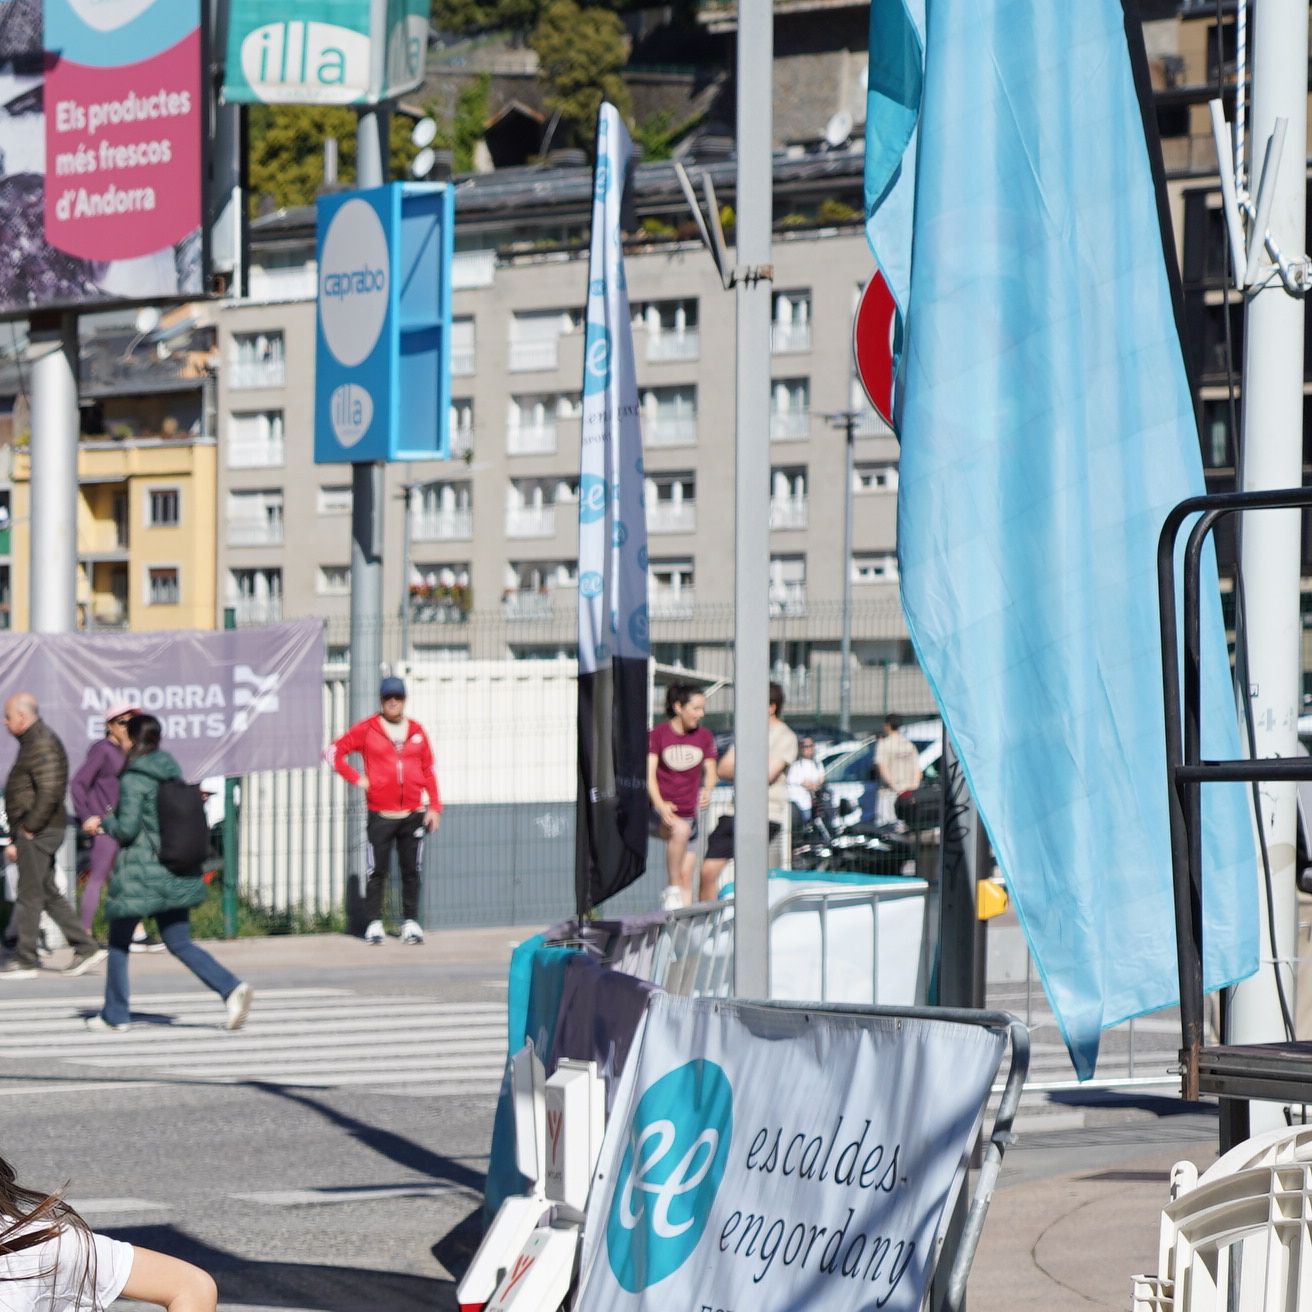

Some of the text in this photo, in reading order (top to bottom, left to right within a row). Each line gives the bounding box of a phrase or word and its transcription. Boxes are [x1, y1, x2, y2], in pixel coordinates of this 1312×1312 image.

[260, 22, 347, 85] illa
[55, 88, 191, 136] Els productes
[55, 139, 172, 176] més frescos
[55, 182, 156, 221] d'Andorra
[324, 263, 386, 301] caprabo
[335, 384, 362, 426] illa
[80, 683, 226, 711] ANDORRA
[719, 1207, 916, 1309] engordany
